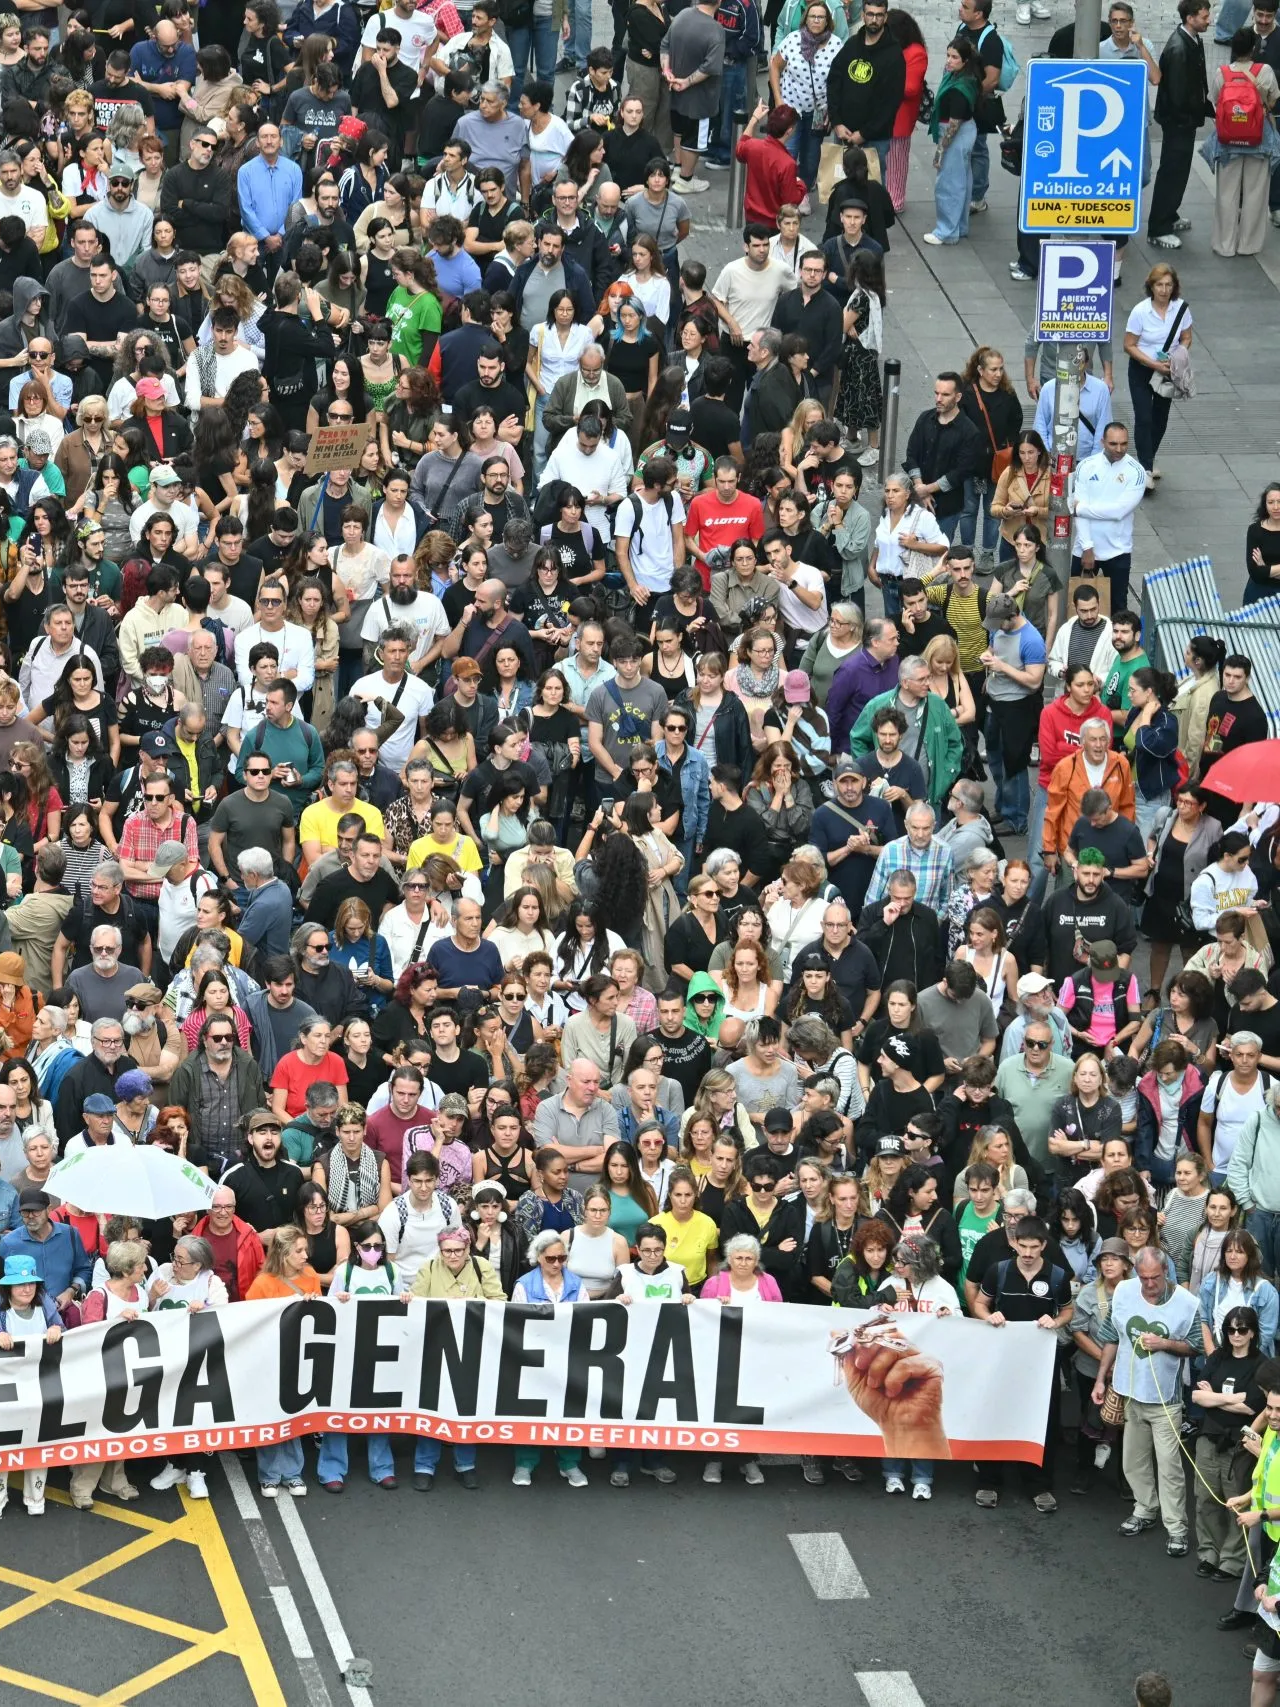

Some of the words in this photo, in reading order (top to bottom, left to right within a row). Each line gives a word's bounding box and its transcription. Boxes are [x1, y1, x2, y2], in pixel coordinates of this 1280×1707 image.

[1047, 83, 1124, 178] P
[1033, 181, 1092, 196] Público
[1096, 183, 1114, 195] 24
[1120, 183, 1131, 195] H
[1032, 203, 1061, 211] LUNA
[1070, 203, 1131, 212] TUDESCOS
[1057, 215, 1071, 224] C/
[1075, 216, 1105, 224] SILVA
[1043, 245, 1099, 311] P
[1061, 295, 1097, 303] ABIERTO
[1061, 302, 1074, 311] 24
[1042, 312, 1061, 321] SIN
[1063, 312, 1108, 321] MULTAS
[334, 442, 354, 451] CASA
[341, 449, 358, 457] CASA
[714, 517, 748, 525] LOTTO
[880, 1138, 901, 1150] TRUE
[279, 1299, 764, 1425] GENERAL
[41, 1436, 167, 1463] FONDOS
[184, 1423, 291, 1449] BUITRE
[327, 1415, 514, 1440] CONTRATOS
[531, 1425, 740, 1448] INDEFINIDOS
